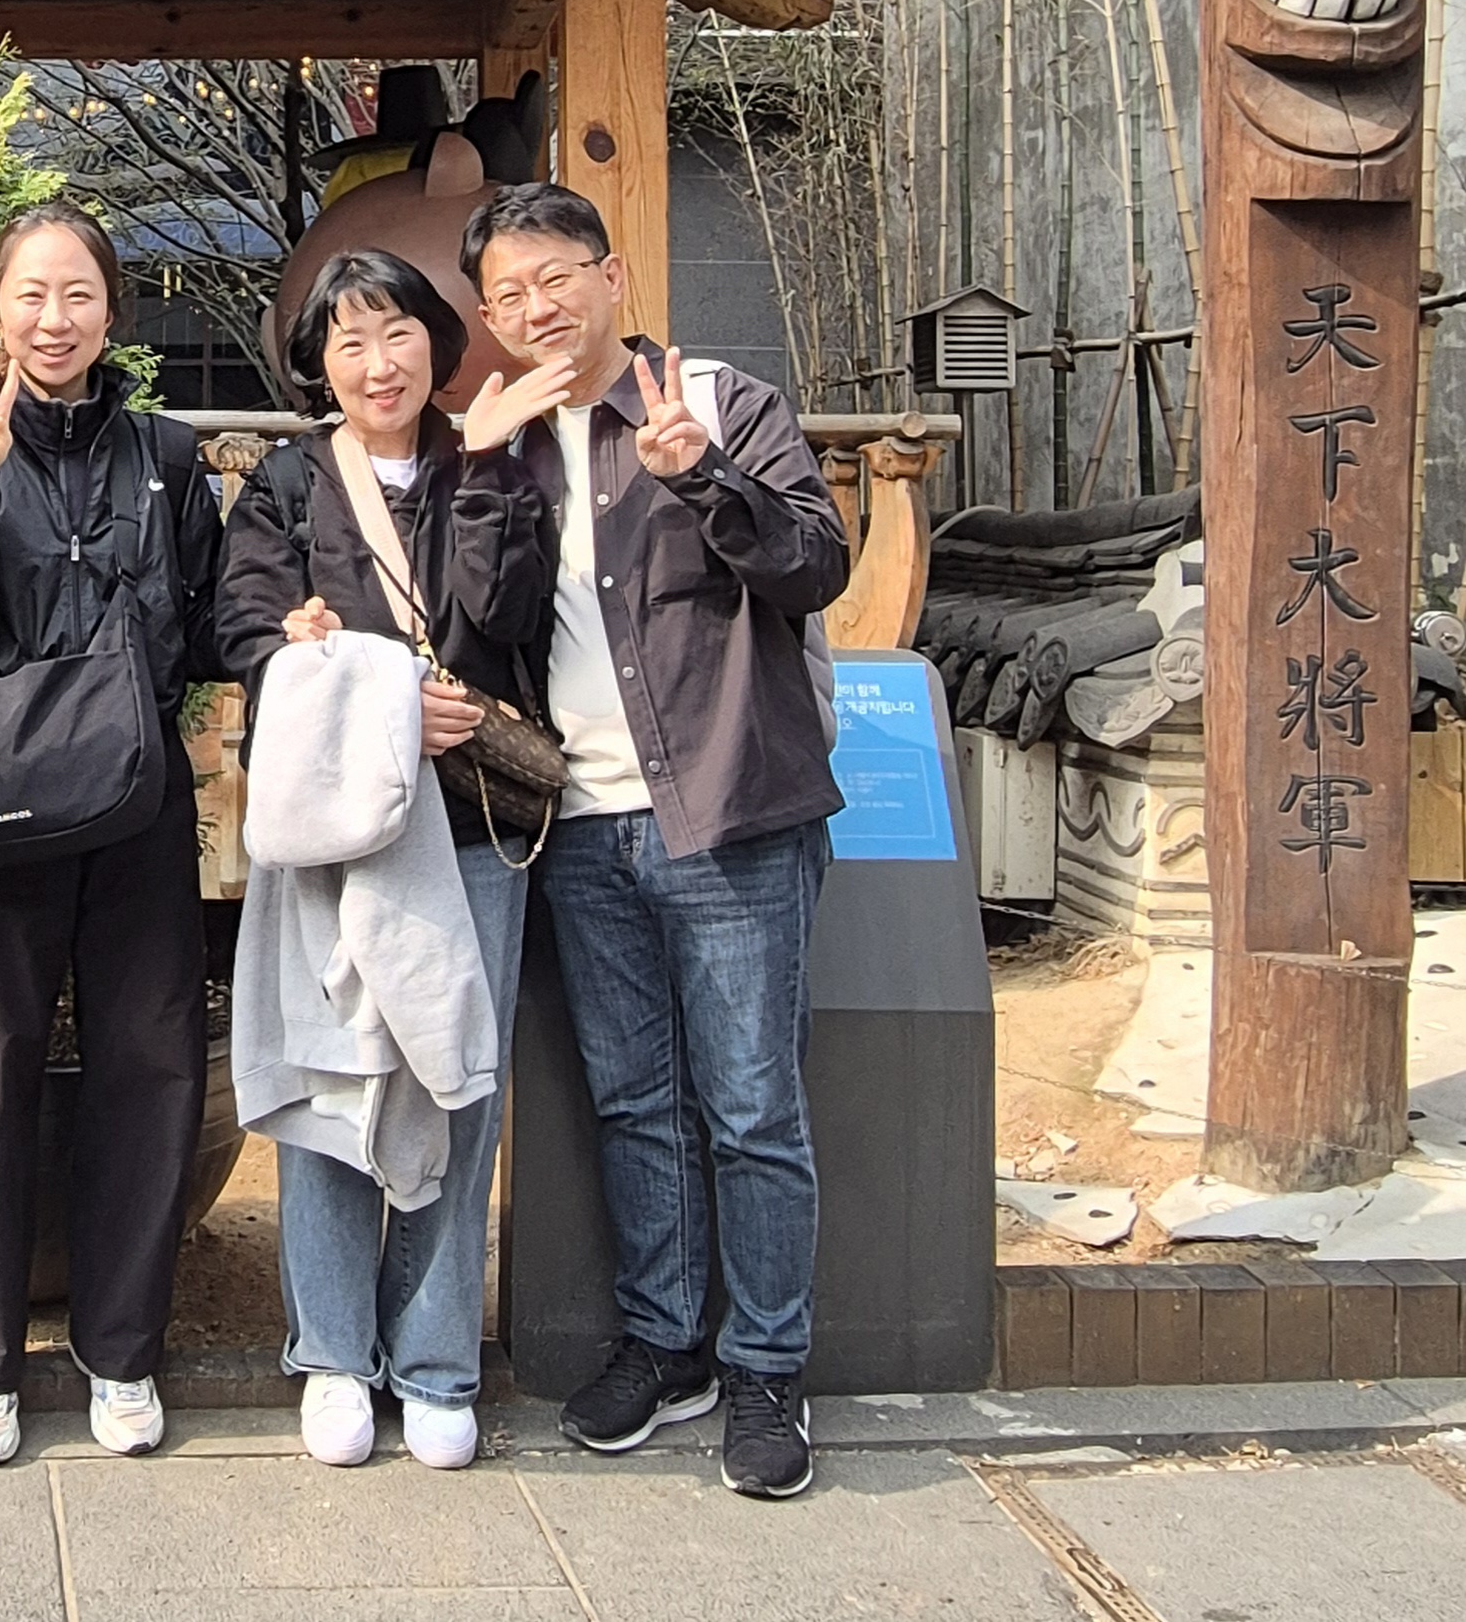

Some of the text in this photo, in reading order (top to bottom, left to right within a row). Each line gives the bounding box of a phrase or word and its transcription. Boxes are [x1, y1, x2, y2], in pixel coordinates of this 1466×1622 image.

[1276, 282, 1385, 876] 天下大將軍
